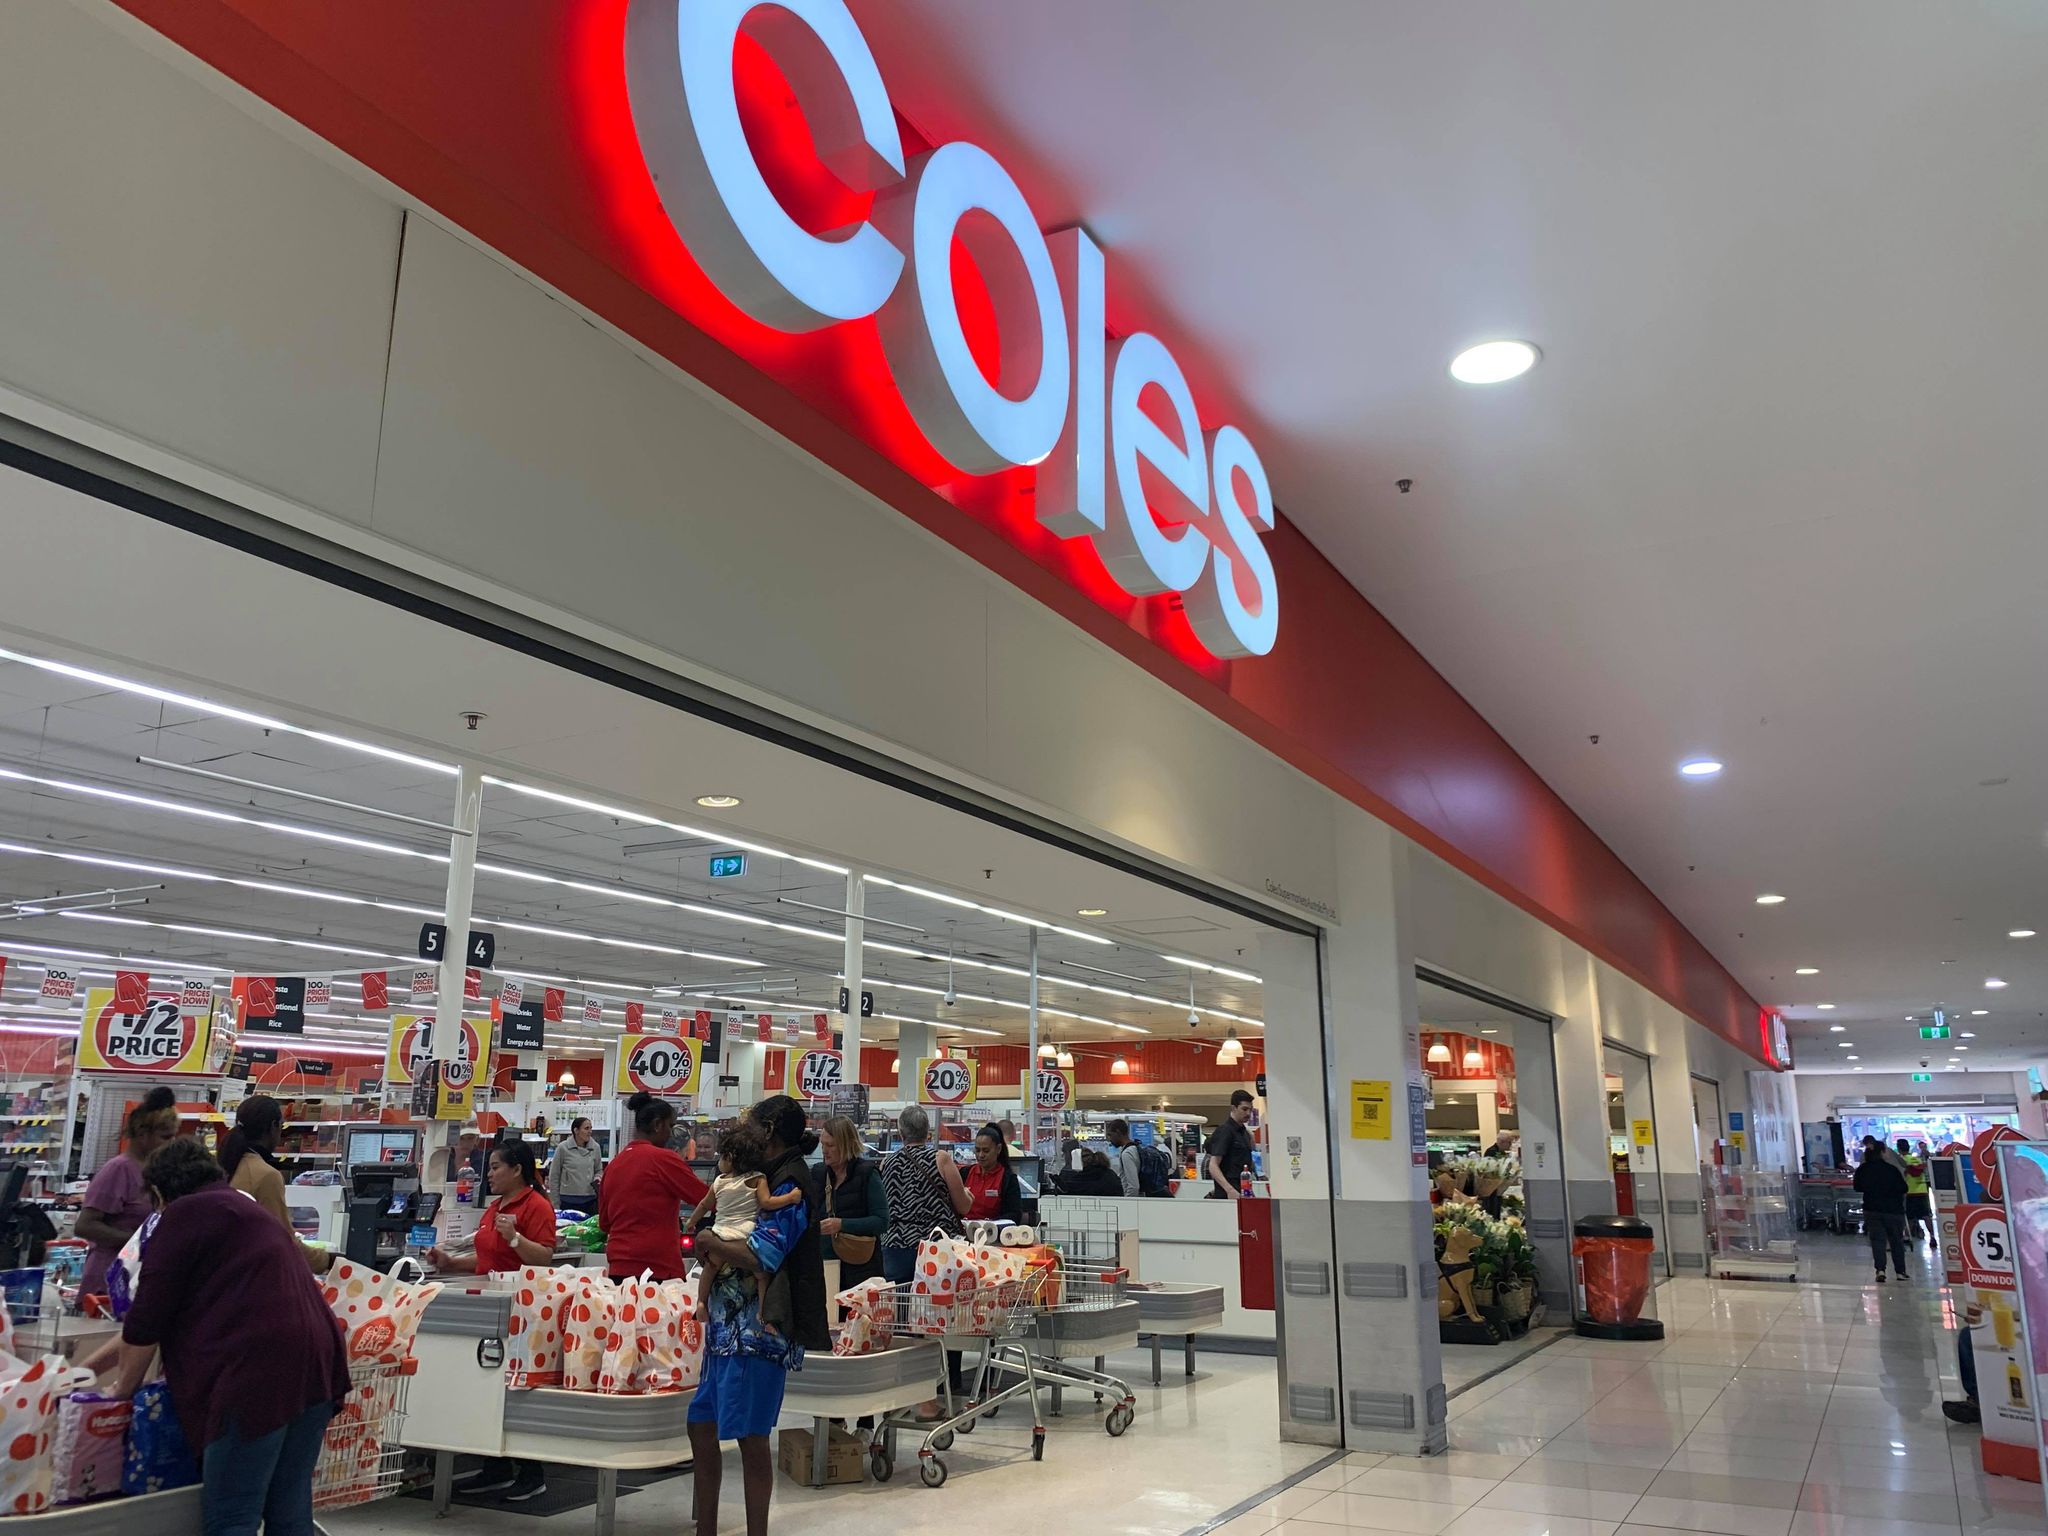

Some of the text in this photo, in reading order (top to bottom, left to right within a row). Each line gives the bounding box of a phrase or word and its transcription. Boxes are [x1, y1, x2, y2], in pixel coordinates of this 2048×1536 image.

[426, 931, 438, 952] 5
[474, 939, 486, 959] 4
[45, 978, 75, 989] PRICES
[412, 985, 433, 993] DOWN
[42, 986, 73, 998] DOWN
[184, 990, 211, 998] PRICES
[275, 986, 288, 994] asta
[306, 988, 330, 996] PRICES
[503, 990, 521, 998] PRICES
[182, 996, 209, 1005] DOWN
[306, 995, 329, 1003] DOWN
[501, 996, 520, 1004] DOWN
[841, 992, 847, 1007] 3
[862, 996, 869, 1011] 2
[517, 1009, 533, 1017] Drinks
[268, 1019, 283, 1028] Rice
[516, 1023, 532, 1032] Water
[108, 1036, 181, 1058] PRICE
[506, 1037, 539, 1048] Energy drinks
[629, 1050, 690, 1077] 40%
[806, 1053, 841, 1078] 1/2
[444, 1063, 472, 1080] 10%
[669, 1069, 690, 1078] OFF
[926, 1069, 969, 1090] 20%
[1037, 1074, 1063, 1093] 1/2
[955, 1083, 969, 1091] OFF
[1036, 1092, 1065, 1103] PRICE
[1977, 1230, 2004, 1261] $5
[1971, 1273, 2016, 1285] DOWN DO
[354, 1338, 385, 1353] BAG
